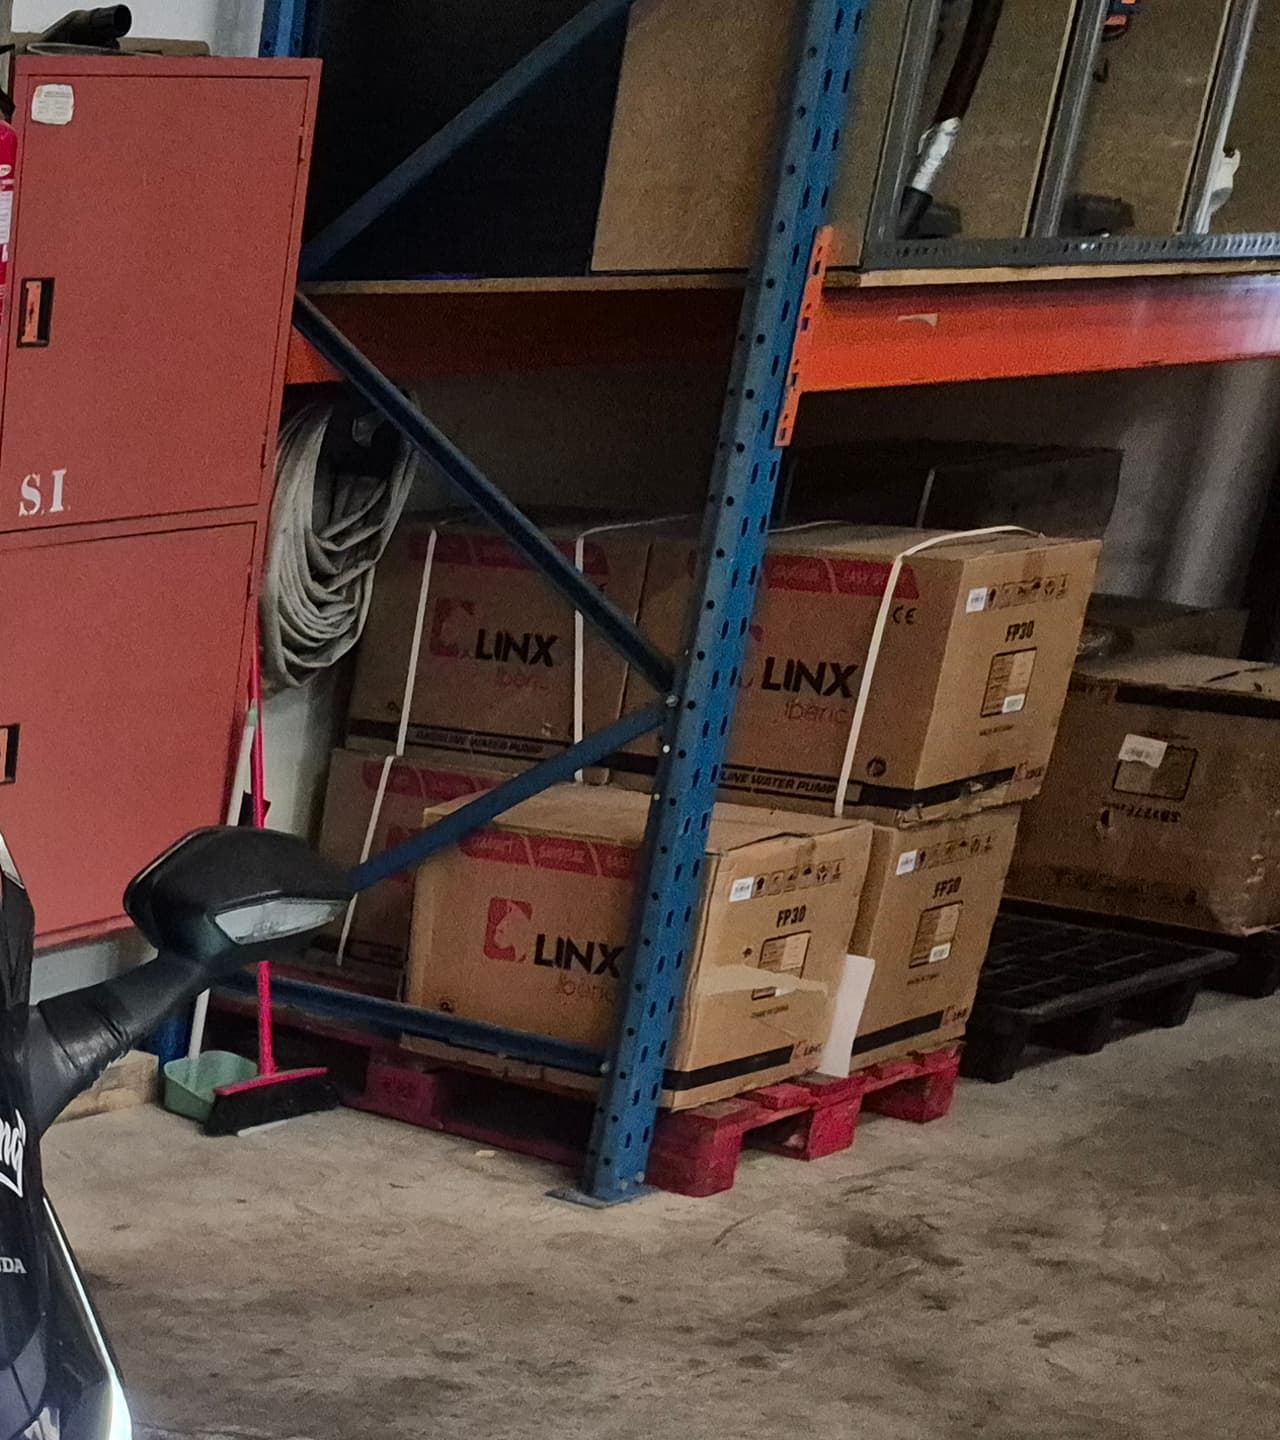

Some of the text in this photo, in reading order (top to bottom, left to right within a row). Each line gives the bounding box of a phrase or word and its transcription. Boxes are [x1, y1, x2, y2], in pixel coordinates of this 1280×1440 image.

[1004, 620, 1035, 643] FP30
[475, 628, 559, 668] LINX
[761, 656, 859, 699] LINX
[750, 772, 794, 790] WATER
[796, 780, 837, 795] PUMP
[776, 904, 807, 928] FP30
[533, 933, 624, 979] LINX
